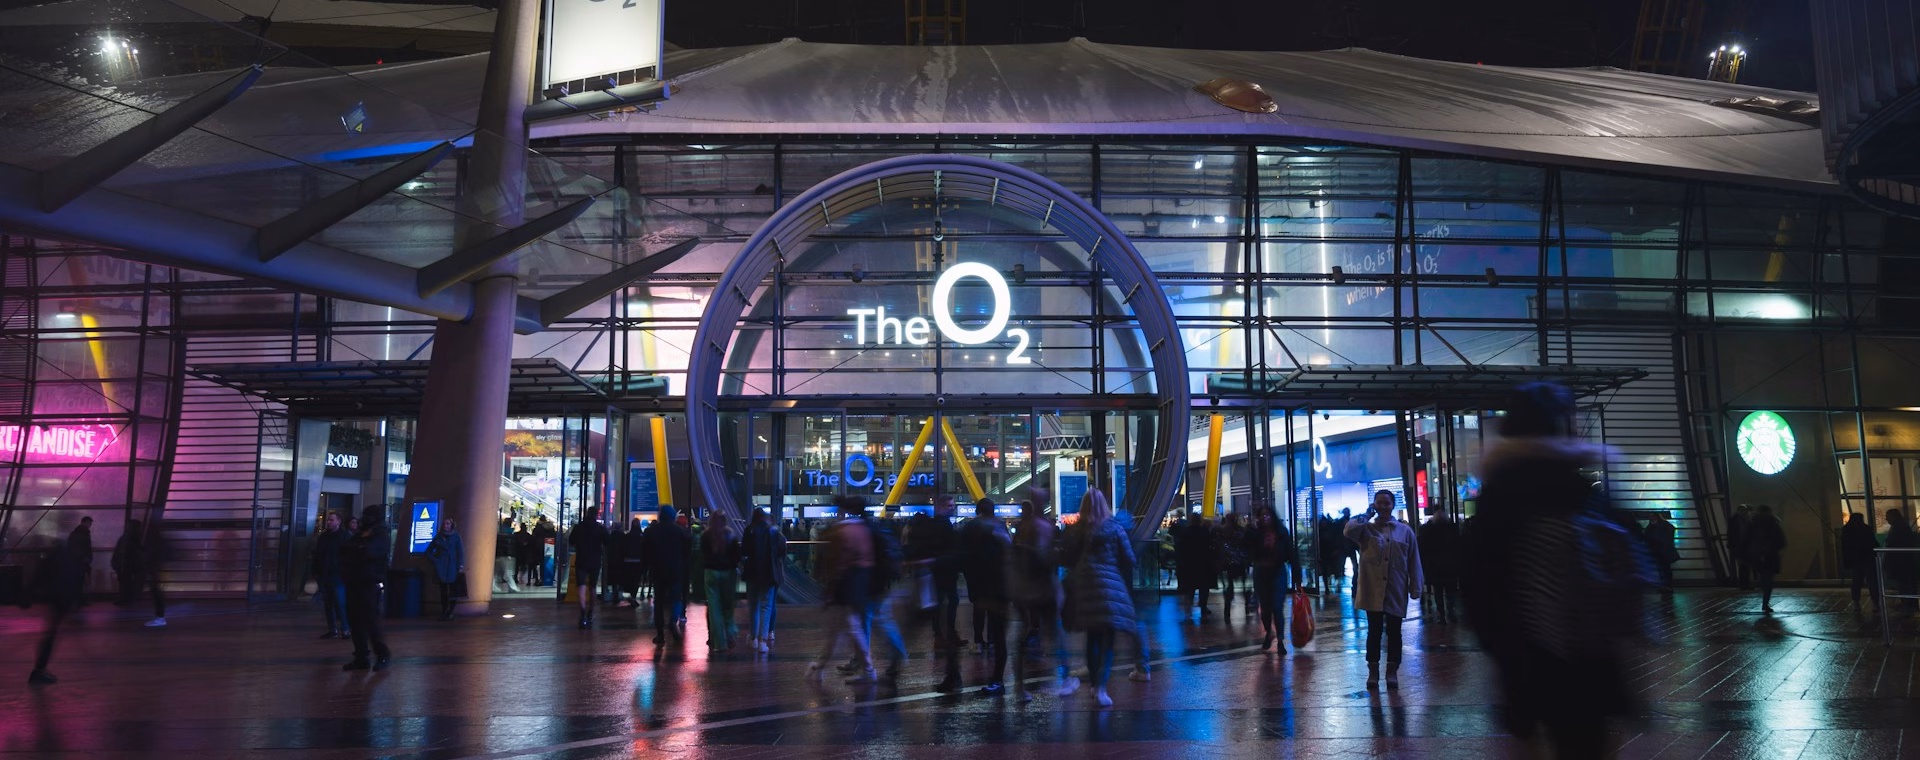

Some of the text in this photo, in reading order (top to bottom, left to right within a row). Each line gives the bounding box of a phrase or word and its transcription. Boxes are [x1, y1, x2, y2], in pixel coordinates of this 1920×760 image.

[1364, 254, 1376, 272] O2
[1378, 249, 1386, 266] is
[846, 262, 1031, 364] The O2
[806, 453, 935, 493] The O2 aena
[1312, 437, 1333, 479] O2
